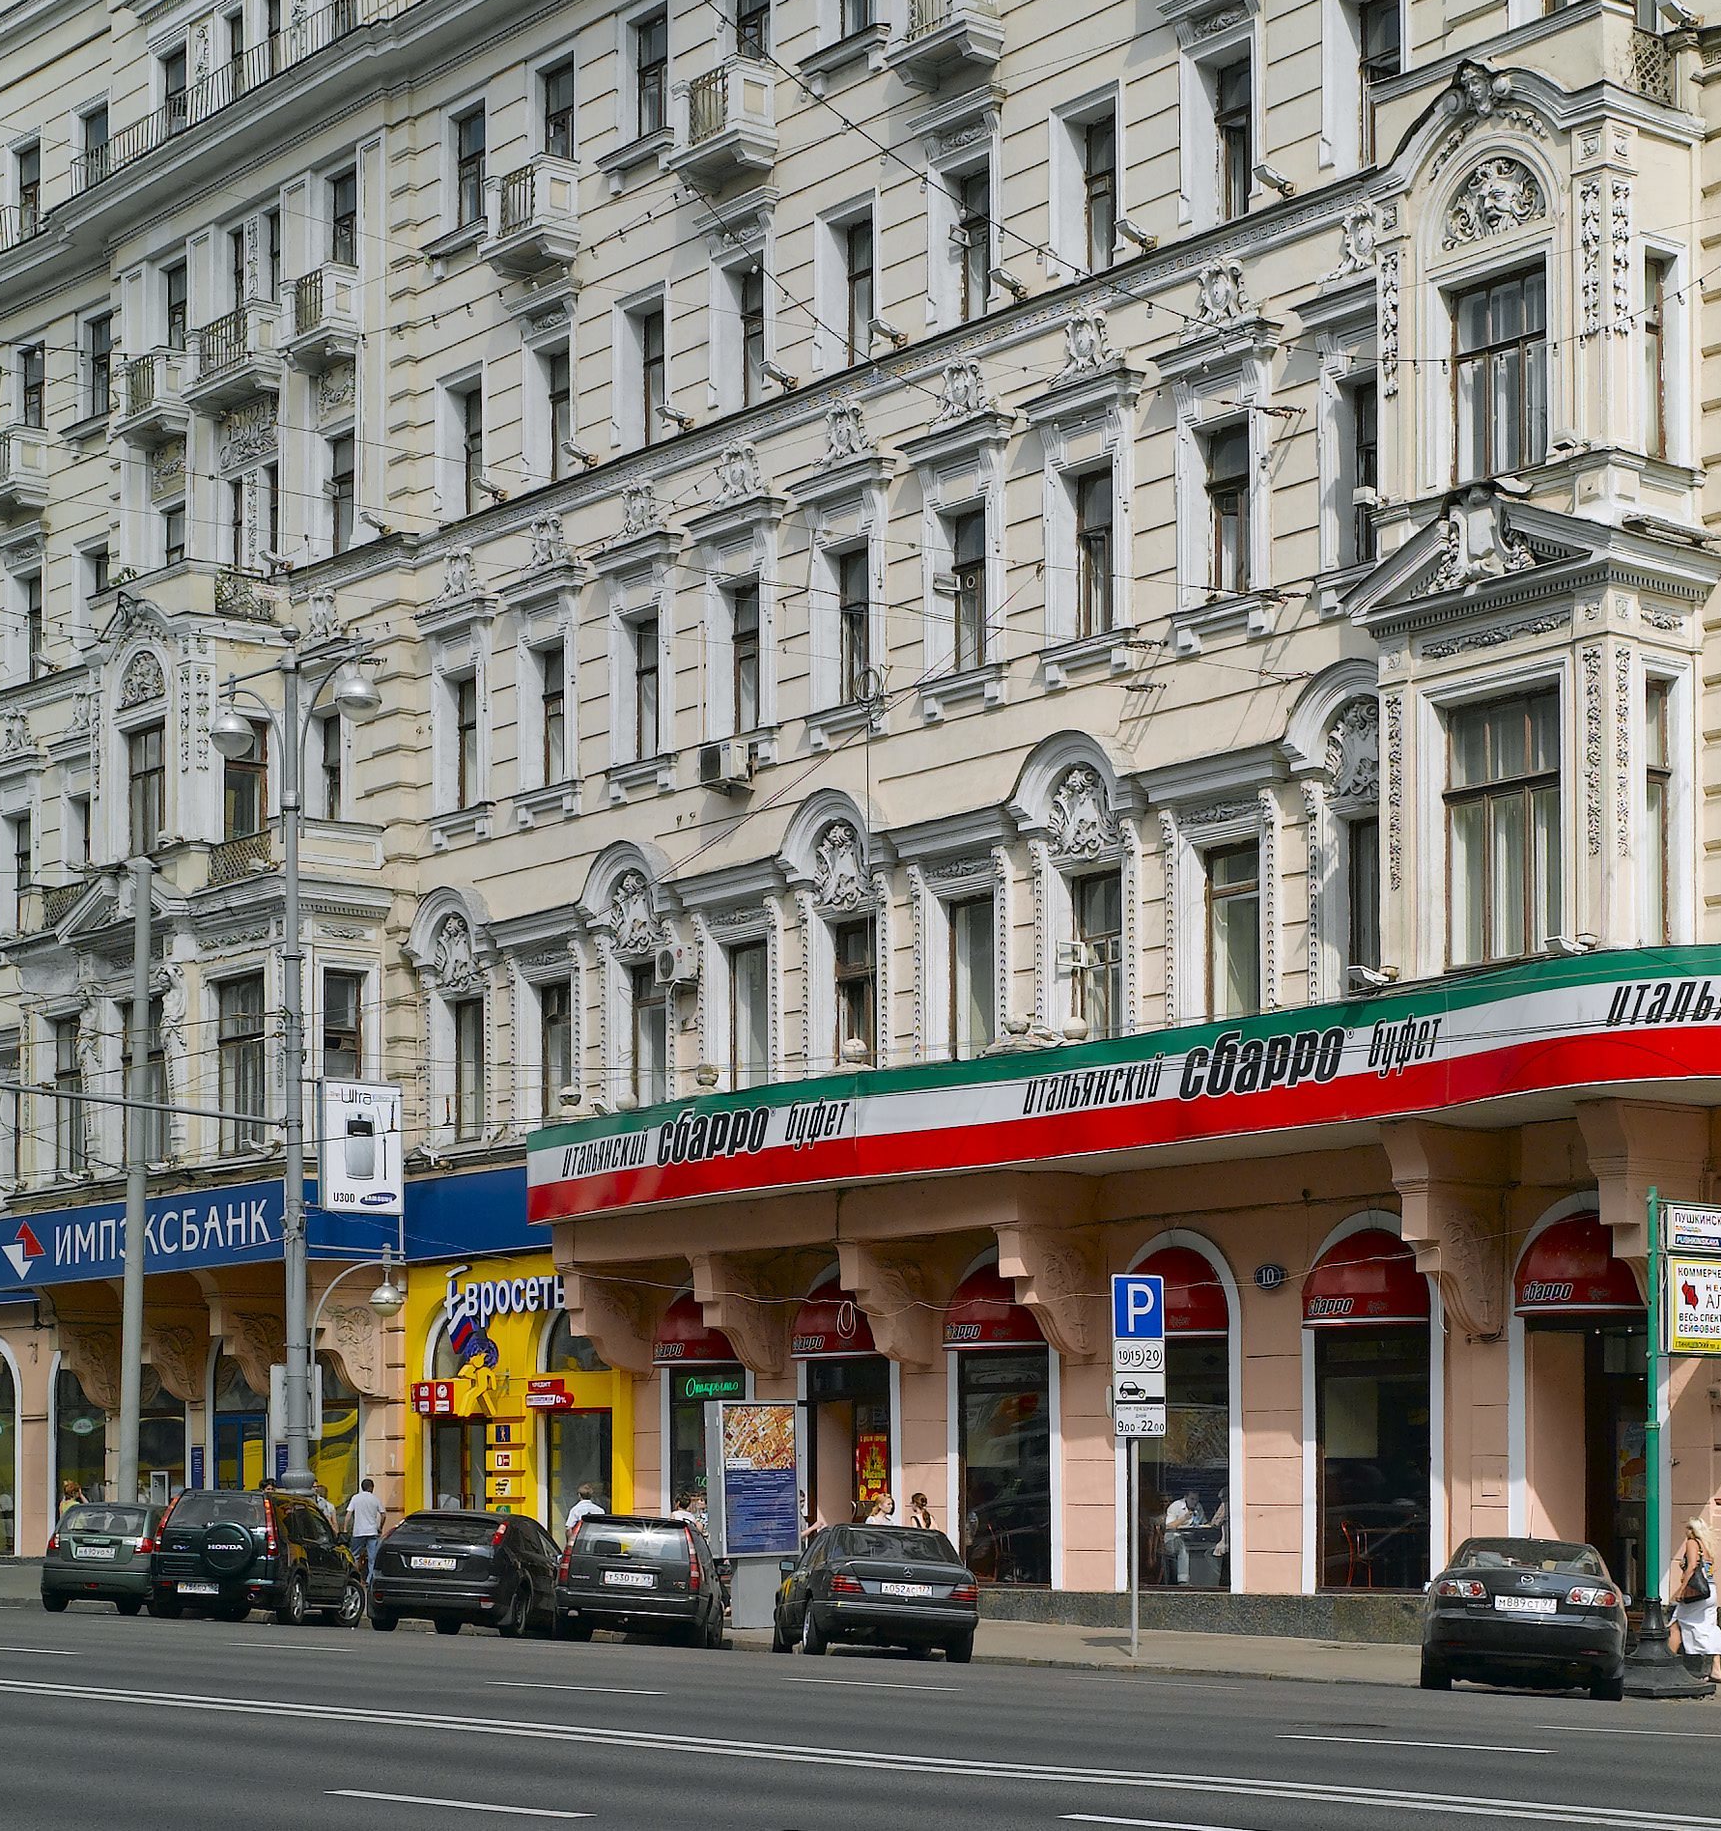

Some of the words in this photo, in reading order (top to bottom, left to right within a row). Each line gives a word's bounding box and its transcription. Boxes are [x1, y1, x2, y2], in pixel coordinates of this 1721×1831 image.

[1022, 1053, 1165, 1116] итальянский
[1179, 1027, 1347, 1102] сбарро
[1367, 1014, 1442, 1078] буфет
[341, 1087, 373, 1106] Ultra
[562, 1125, 649, 1178] итальянский
[656, 1106, 772, 1168] сбарро
[785, 1097, 850, 1151] буфет
[333, 1192, 356, 1203] U300
[1262, 1270, 1274, 1283] 10
[443, 1264, 565, 1328] Евросеть
[1522, 1281, 1573, 1303] сбарро
[1678, 1312, 1699, 1322] ВЕСЬ
[1678, 1322, 1720, 1334] СЕЙФОВЫЕ
[1117, 1349, 1128, 1361] 10
[1130, 1349, 1142, 1362] 15
[1145, 1348, 1160, 1363] 20
[685, 1376, 740, 1398] Открыто
[555, 1394, 567, 1404] 0%
